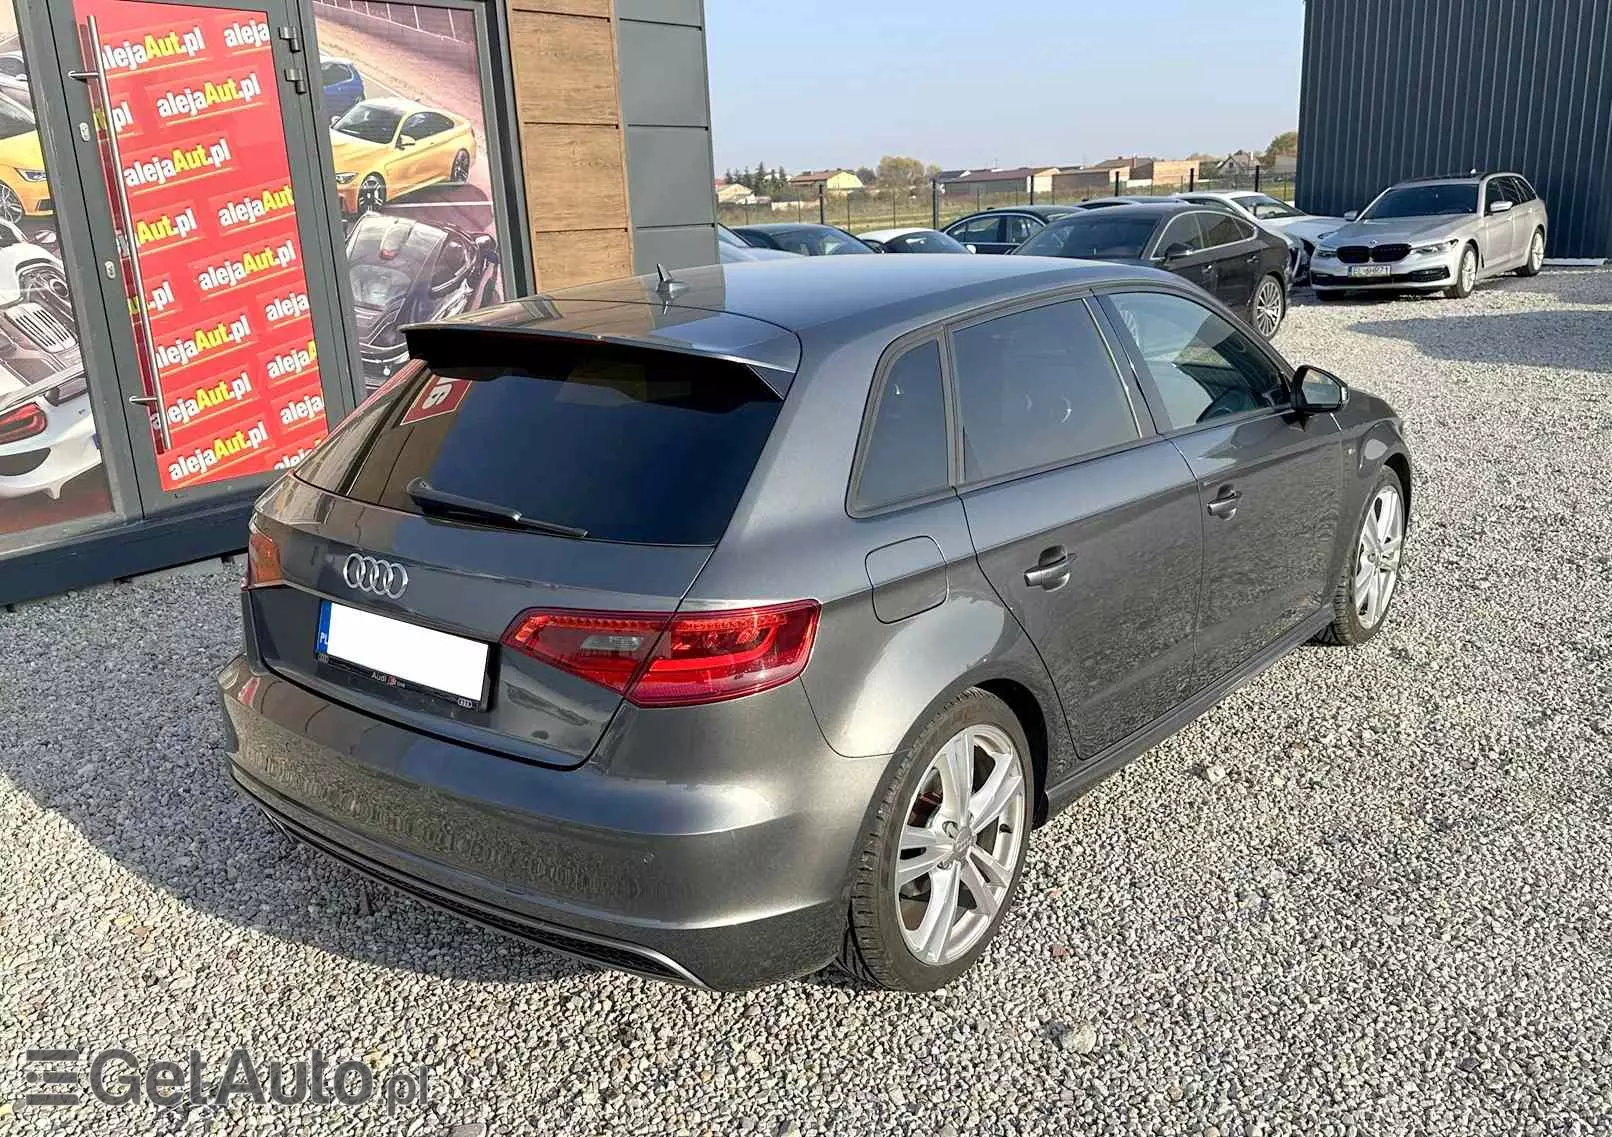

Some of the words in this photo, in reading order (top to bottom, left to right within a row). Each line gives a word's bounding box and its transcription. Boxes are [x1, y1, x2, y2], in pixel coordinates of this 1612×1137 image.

[157, 73, 260, 117] alejaAut.pl
[123, 138, 231, 186] alejaAut.pl
[198, 240, 296, 290] alejaAut.pl
[168, 420, 267, 480] alejaAut.pl
[371, 671, 387, 683] Audi
